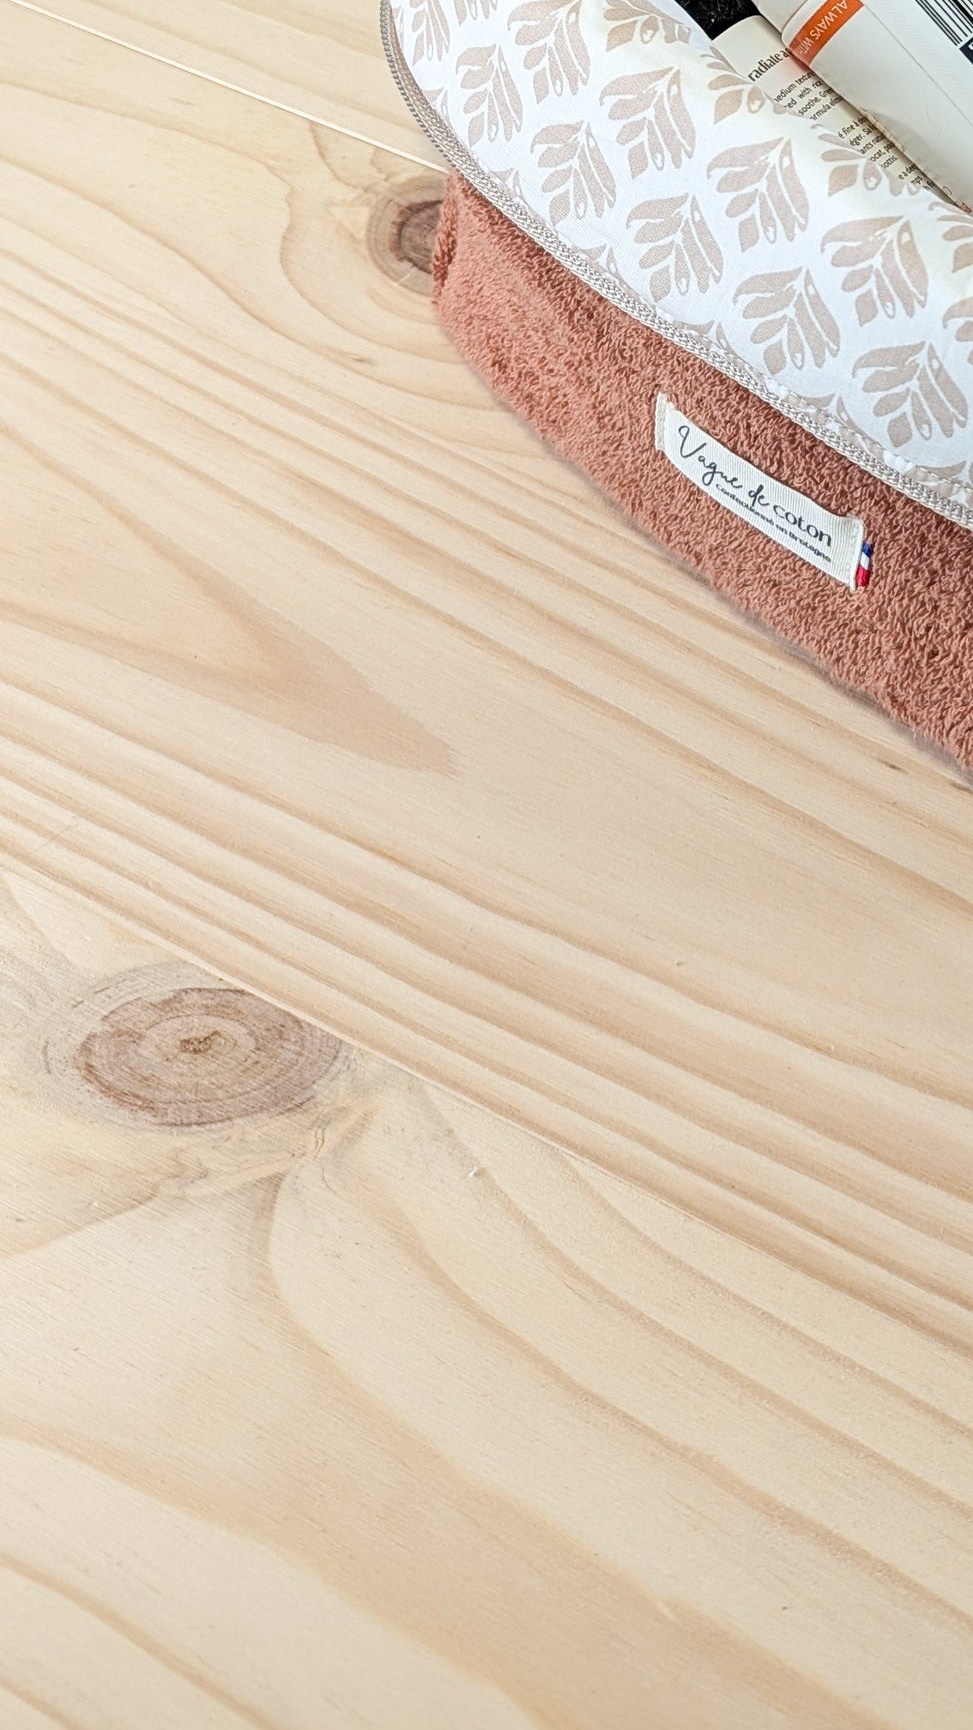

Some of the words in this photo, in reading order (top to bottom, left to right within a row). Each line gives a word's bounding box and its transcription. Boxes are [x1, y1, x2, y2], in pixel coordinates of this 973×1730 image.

[678, 425, 743, 488] Vague
[748, 484, 771, 508] de
[773, 504, 833, 548] coton
